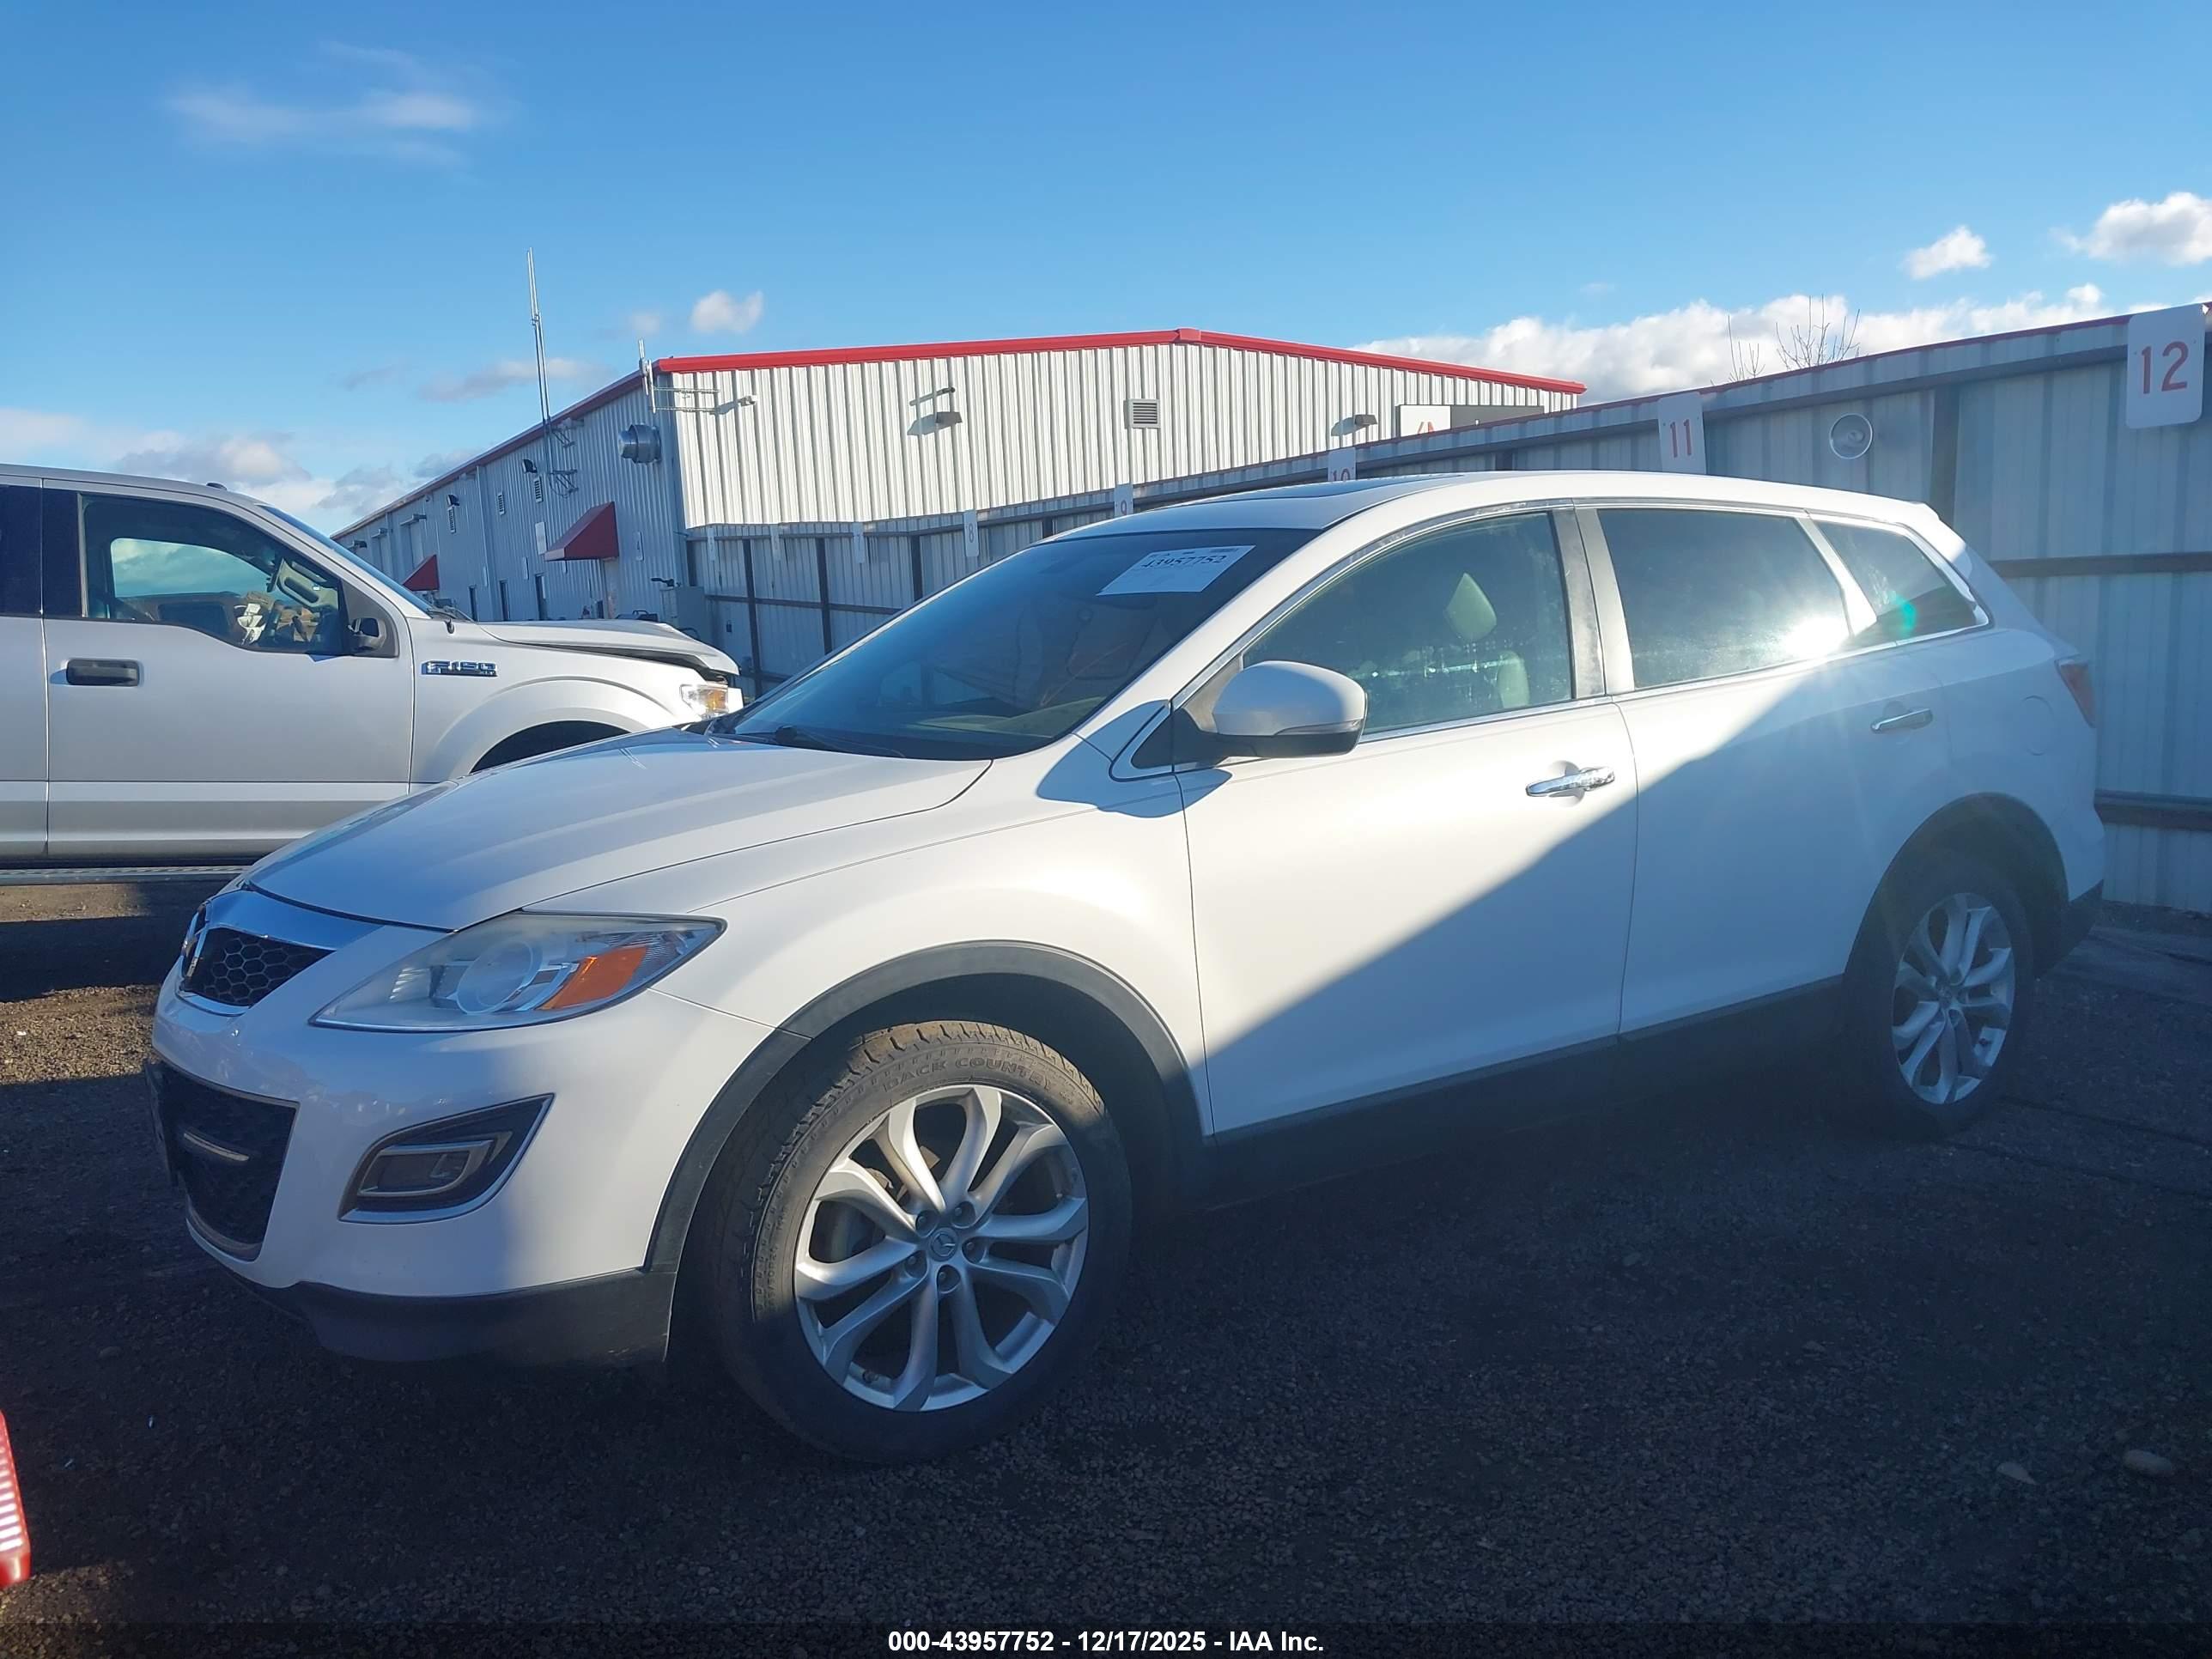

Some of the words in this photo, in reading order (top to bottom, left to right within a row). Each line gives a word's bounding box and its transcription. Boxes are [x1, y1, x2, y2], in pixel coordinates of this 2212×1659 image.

[2142, 341, 2189, 394] 12
[1670, 419, 1692, 458] 11
[967, 523, 975, 544] 8
